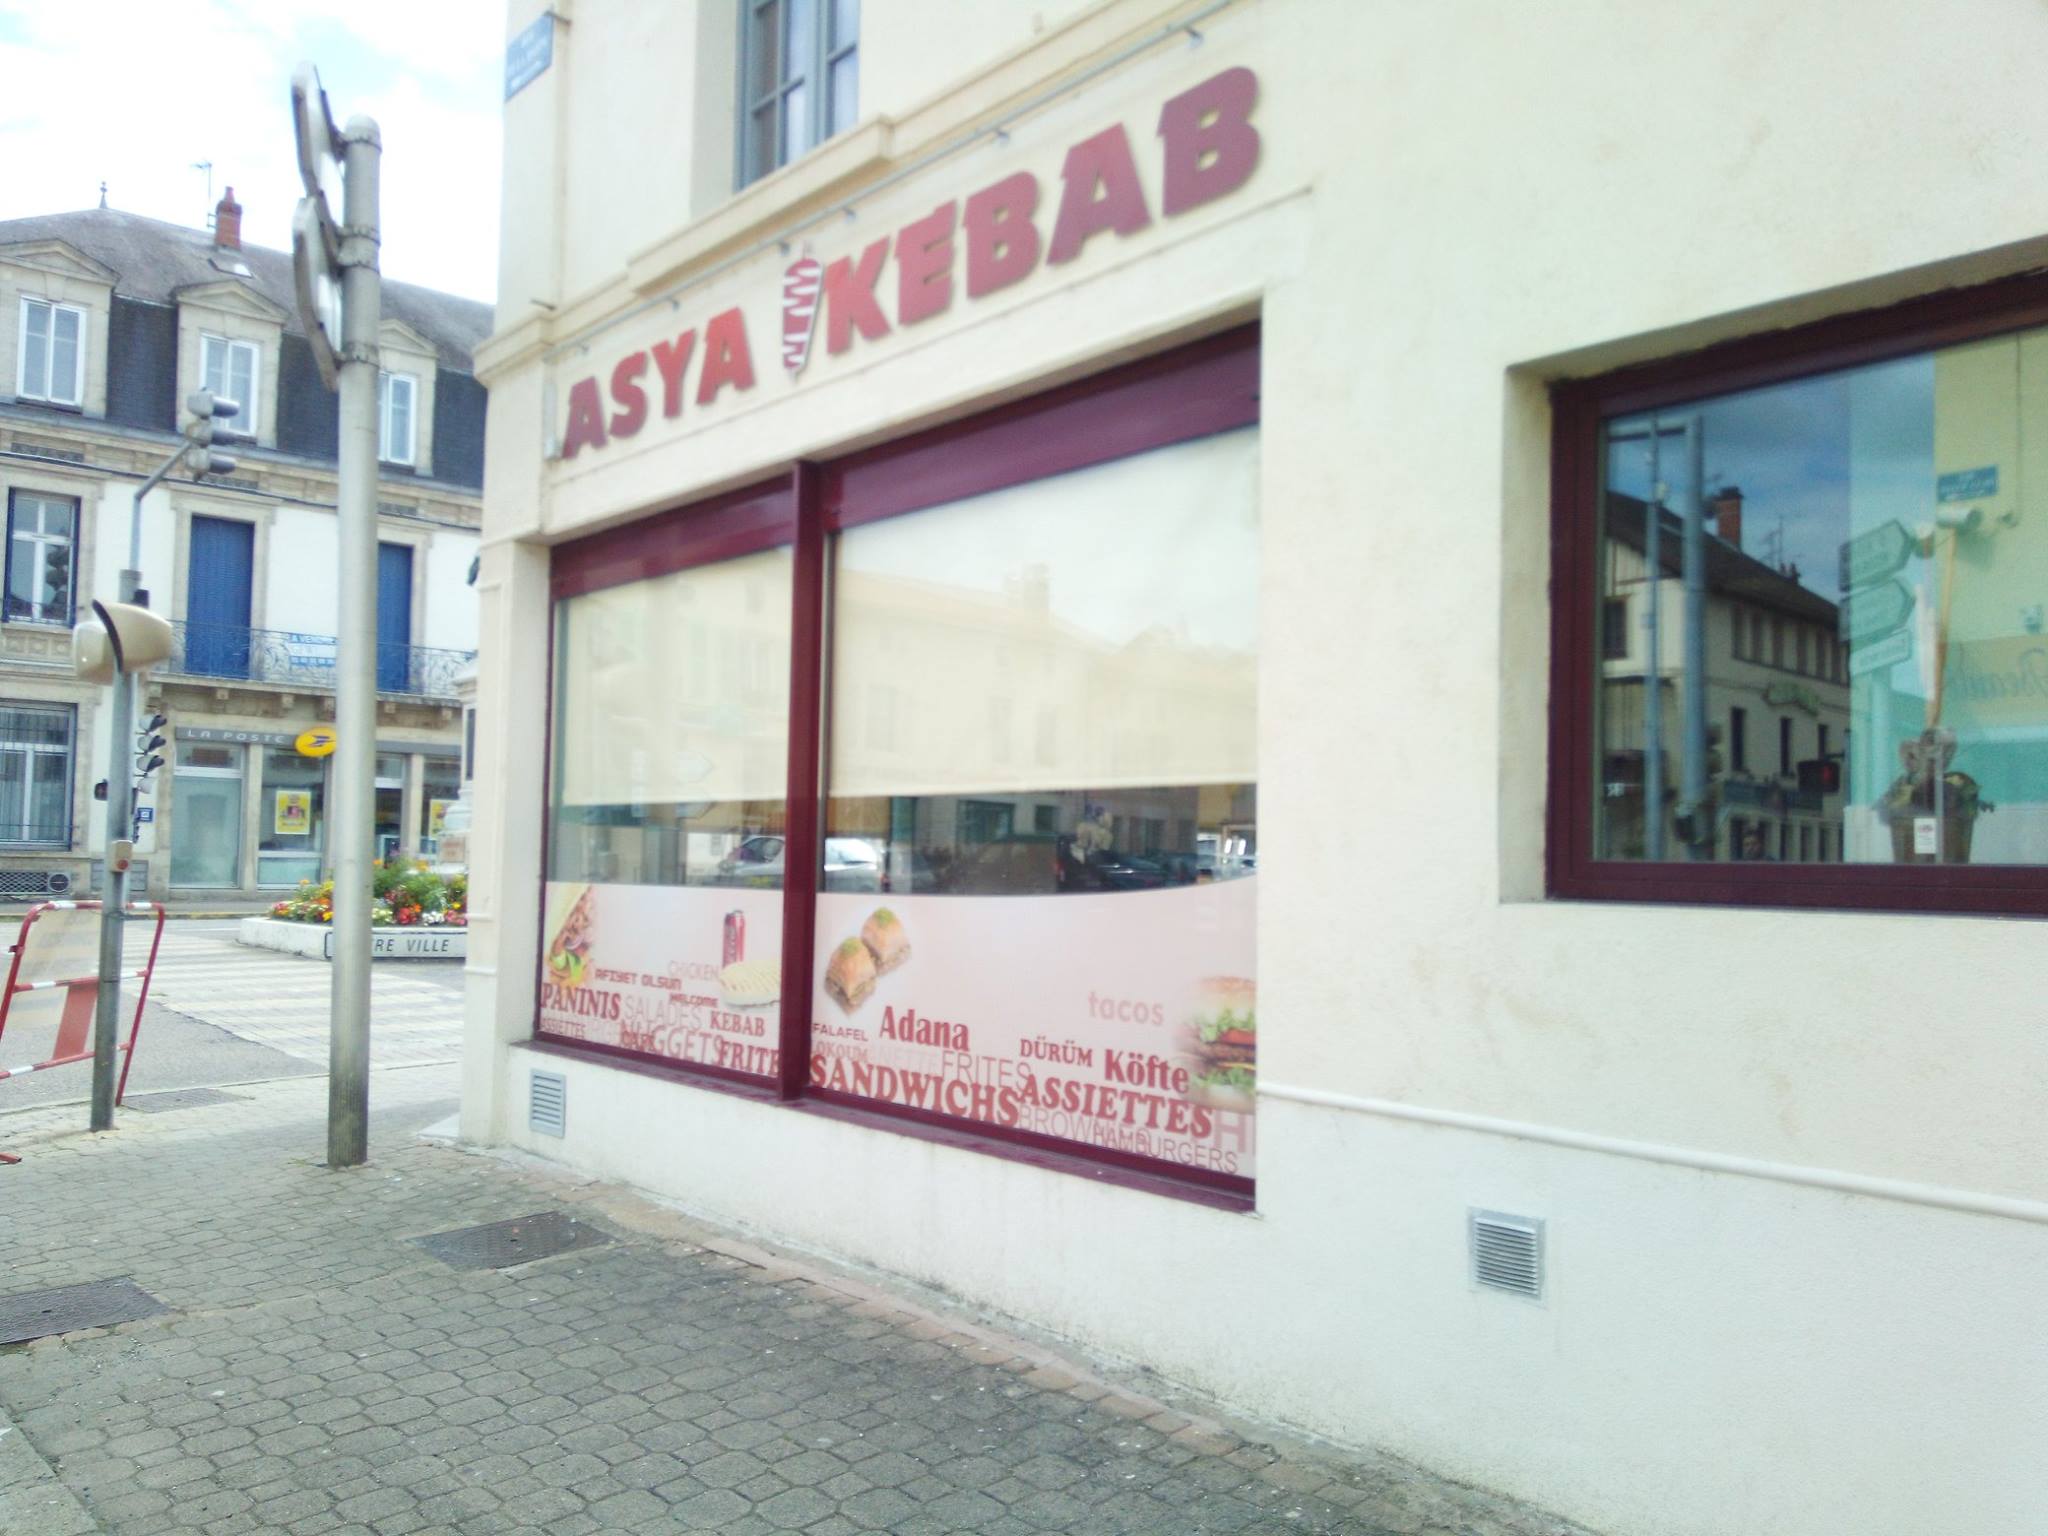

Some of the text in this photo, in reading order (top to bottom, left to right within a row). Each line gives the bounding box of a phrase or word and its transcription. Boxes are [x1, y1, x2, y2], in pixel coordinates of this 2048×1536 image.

[561, 66, 1262, 461] ASYA KEBAB
[187, 729, 286, 744] LA POSTE
[406, 939, 450, 952] VILLE
[540, 981, 621, 1021] PANINIS
[1087, 990, 1165, 1027] tacos
[710, 1010, 766, 1038] KEBAB
[812, 1023, 869, 1042] FALAFEL
[878, 1005, 970, 1053] Adana
[718, 1040, 781, 1079] FRITE
[1019, 1034, 1093, 1068] DÜRÜM
[809, 1053, 1020, 1128] SANDWICHS
[942, 1050, 1034, 1093] FRITES
[1103, 1048, 1189, 1095] Köfte
[1018, 1073, 1214, 1140] ASSIETTES
[1093, 1121, 1239, 1176] HAMBURGERS
